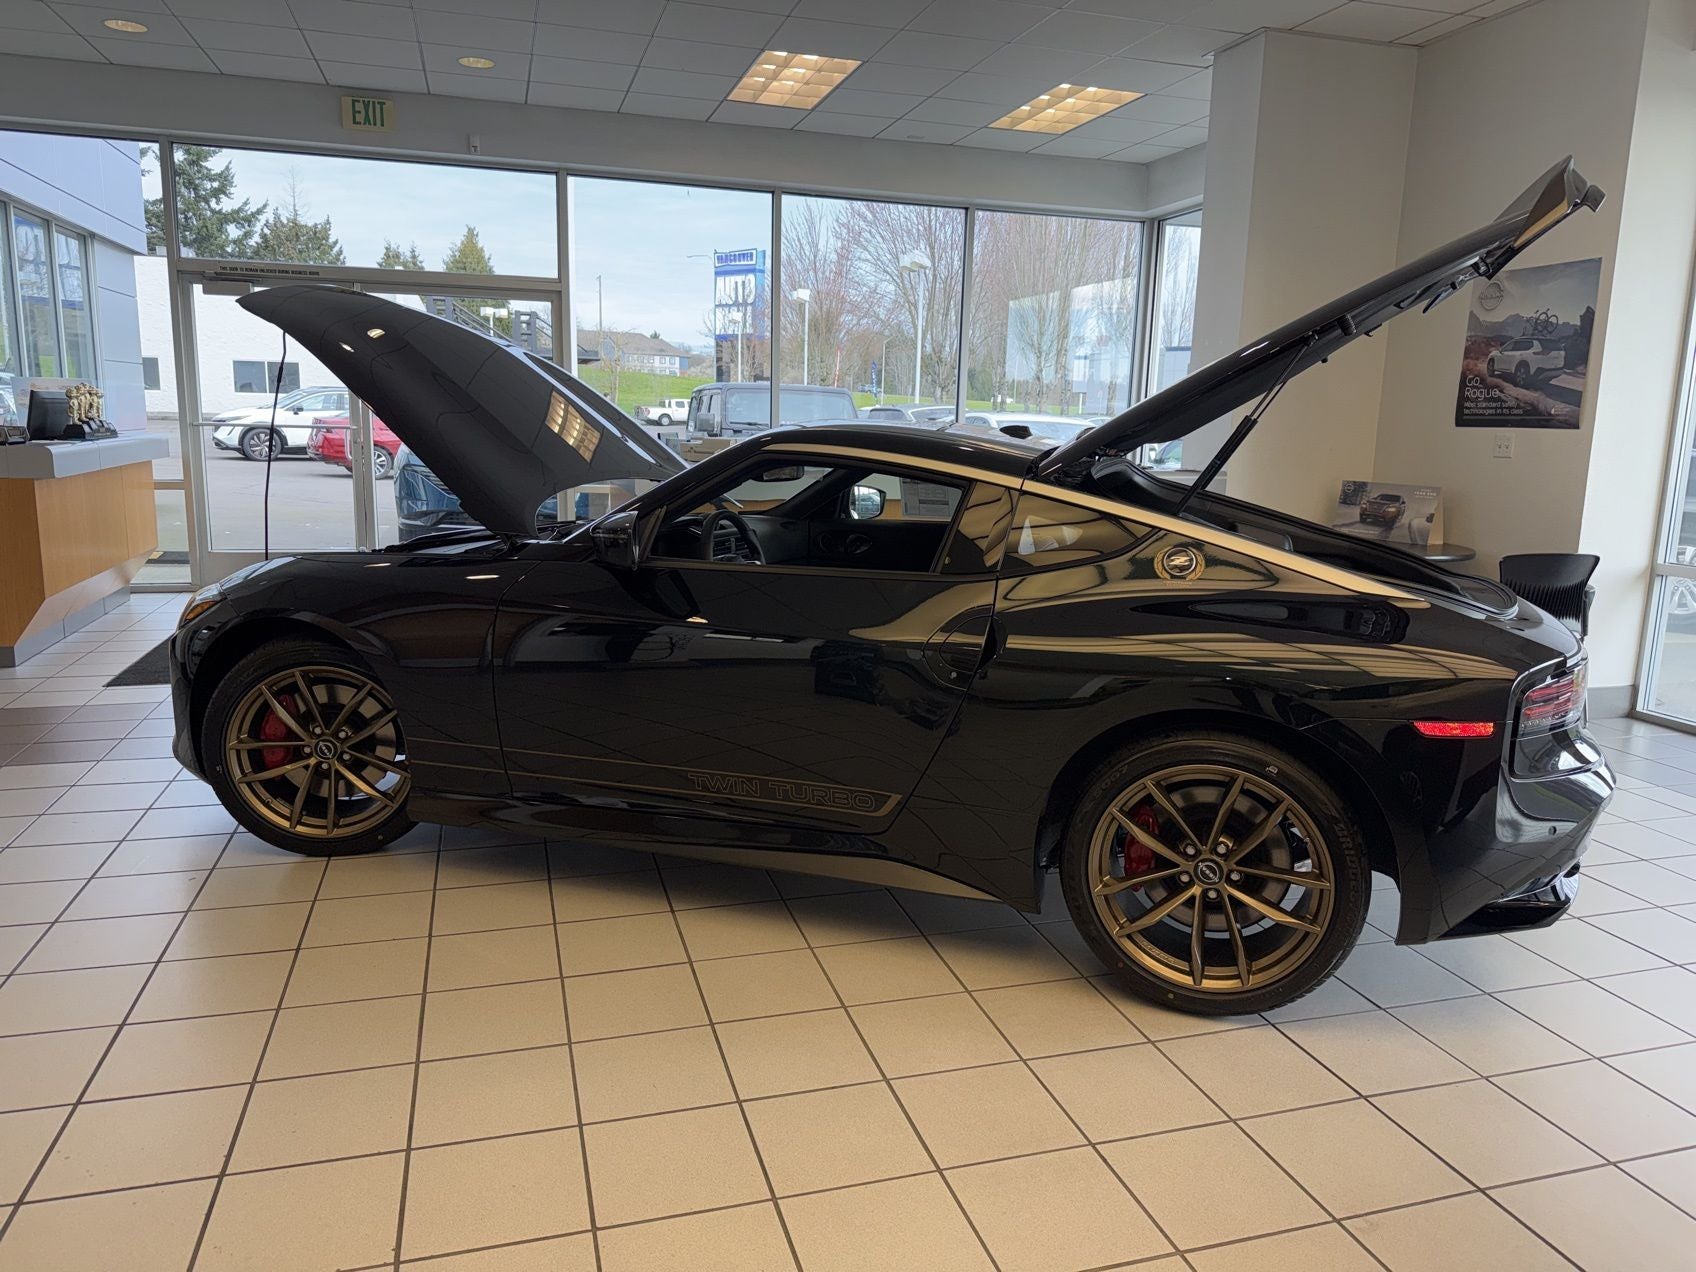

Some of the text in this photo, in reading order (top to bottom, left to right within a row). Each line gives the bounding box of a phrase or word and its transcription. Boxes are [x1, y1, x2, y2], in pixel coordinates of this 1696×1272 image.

[352, 98, 386, 127] EXIT
[1464, 388, 1499, 401] Rogue
[1502, 401, 1518, 409] safety
[687, 771, 876, 811] TWIN TURBO
